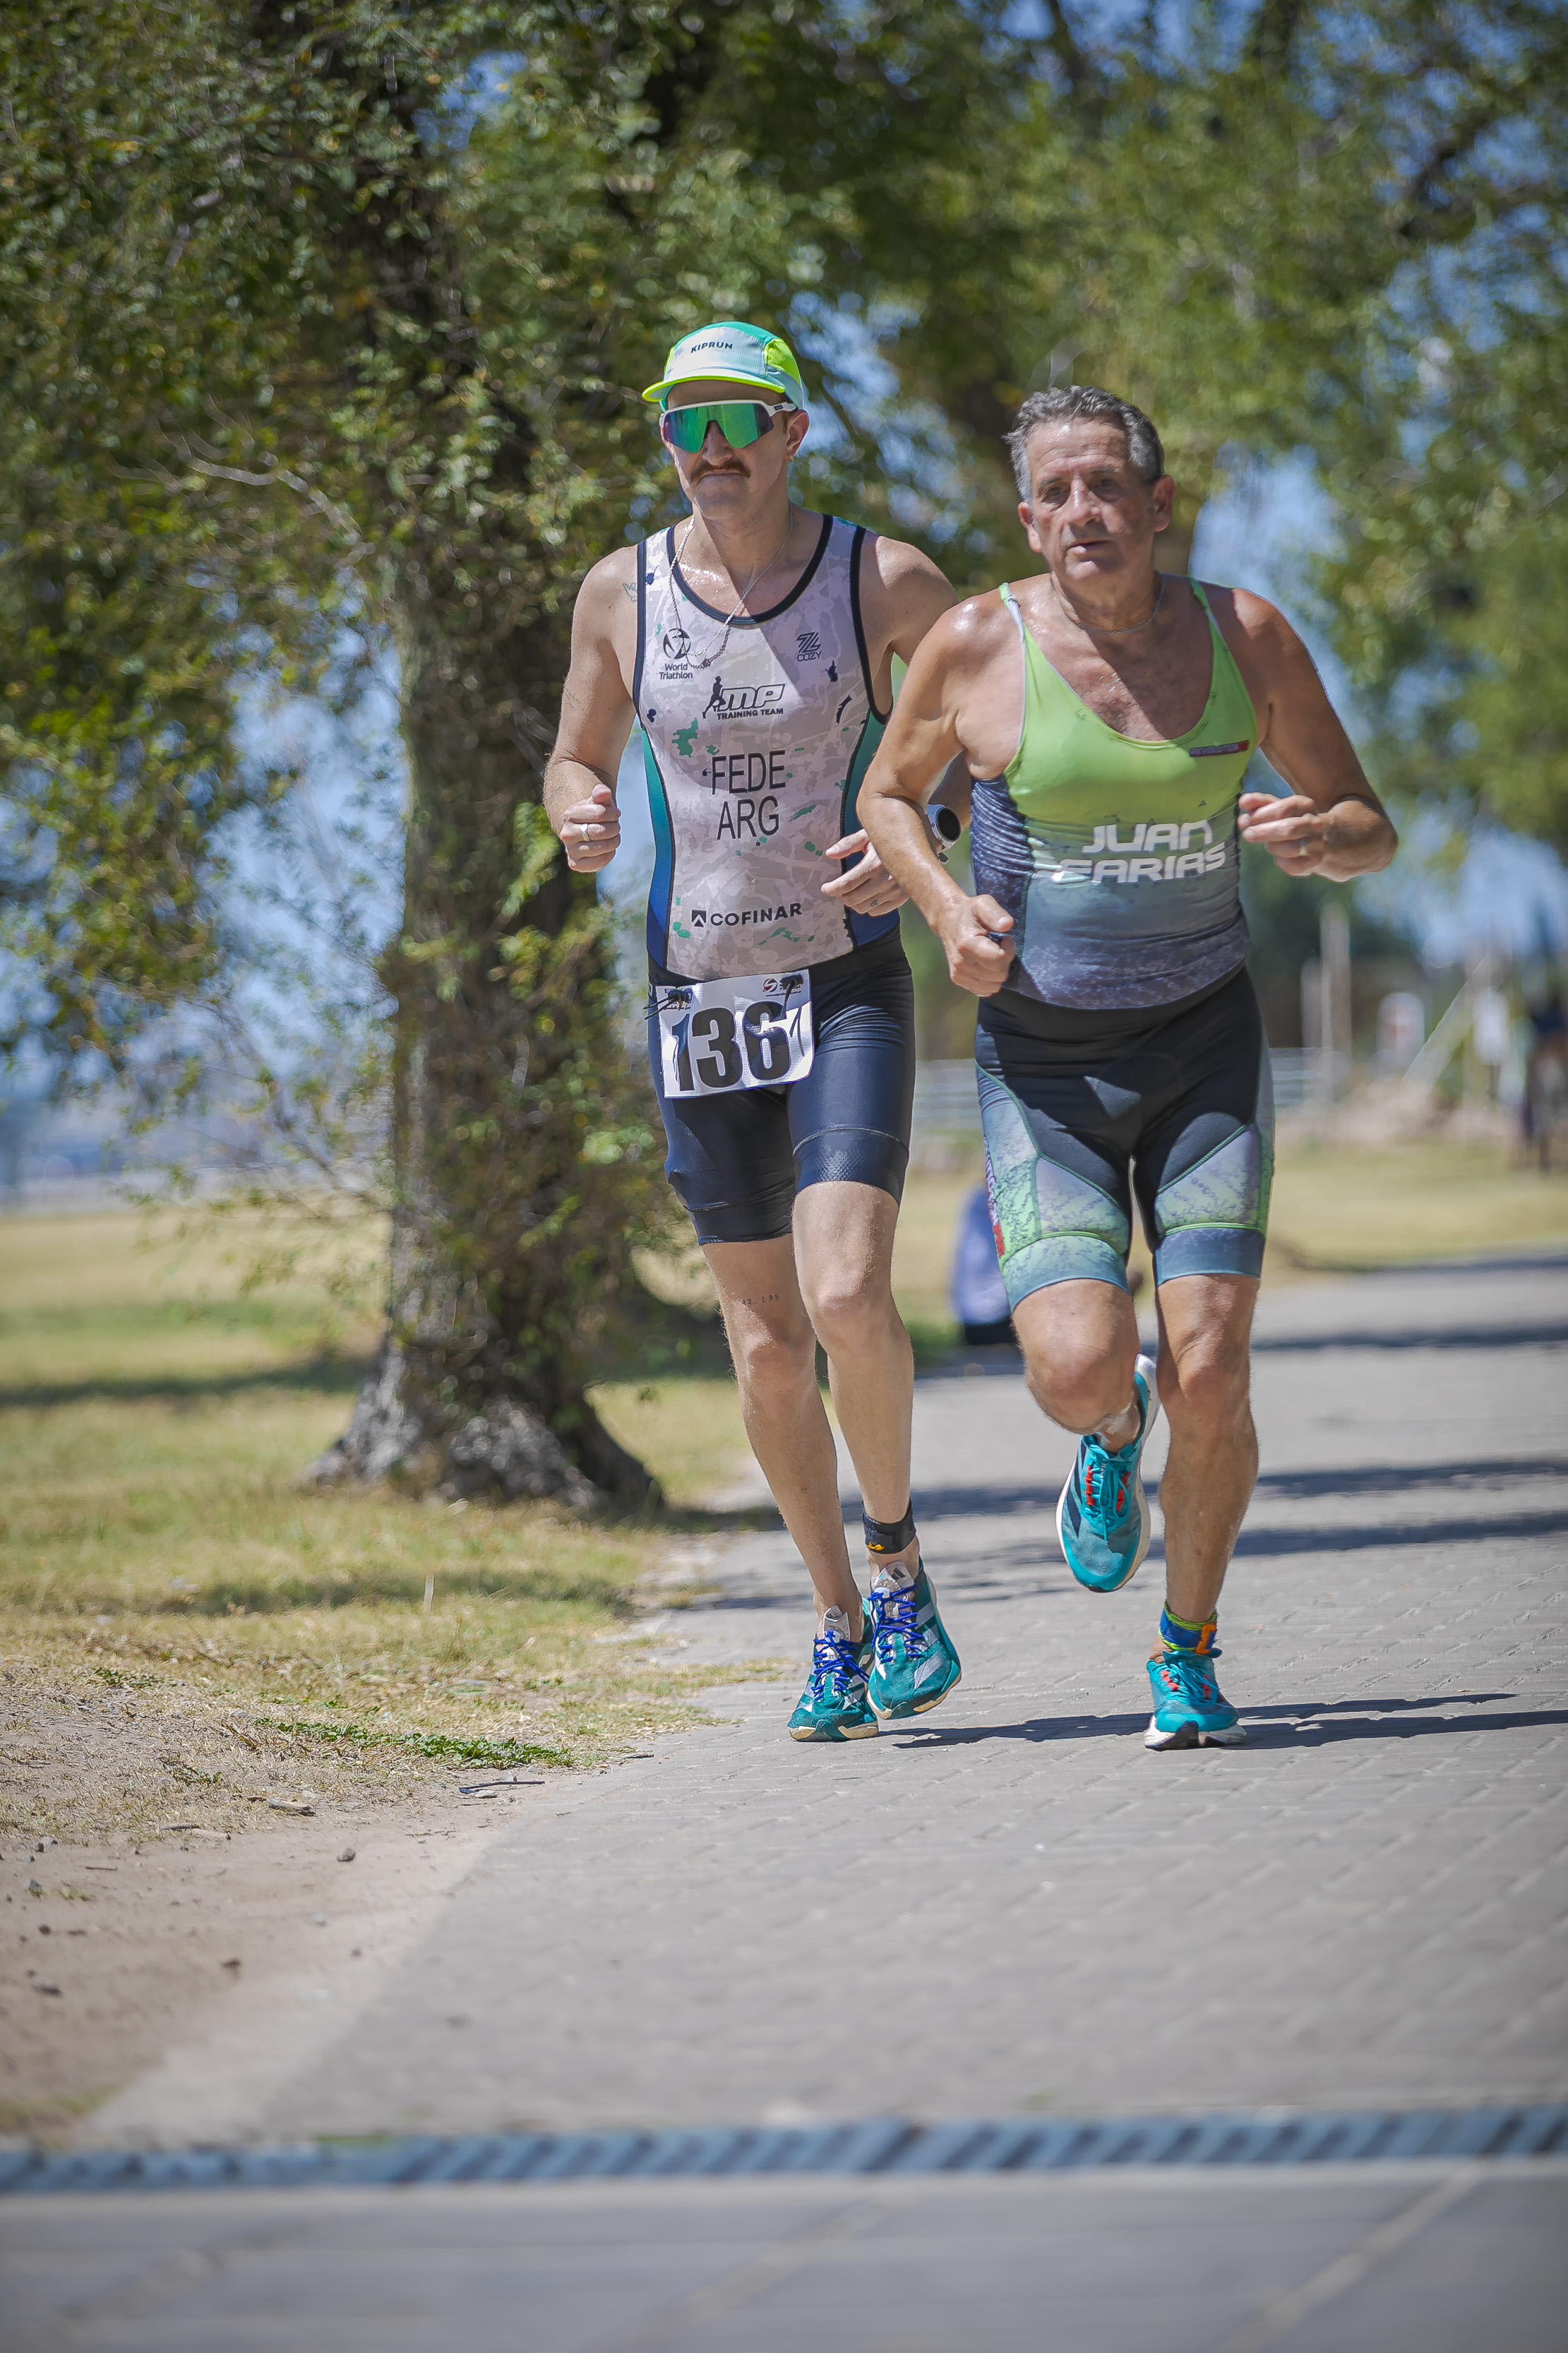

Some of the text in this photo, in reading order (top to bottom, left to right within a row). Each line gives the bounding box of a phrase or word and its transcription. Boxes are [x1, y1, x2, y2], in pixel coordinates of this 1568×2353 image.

[690, 341, 733, 354] KIPRUN
[664, 662, 688, 671] World
[797, 650, 822, 662] COZY
[659, 671, 693, 680] Triathlon
[717, 708, 784, 720] TRAINING TEAM
[712, 749, 786, 795] FEDE
[717, 794, 779, 840] ARG
[1082, 819, 1213, 853] JUAN
[1057, 842, 1226, 883] FARIAS
[710, 903, 803, 927] COFINAR
[671, 1001, 791, 1092] 136
